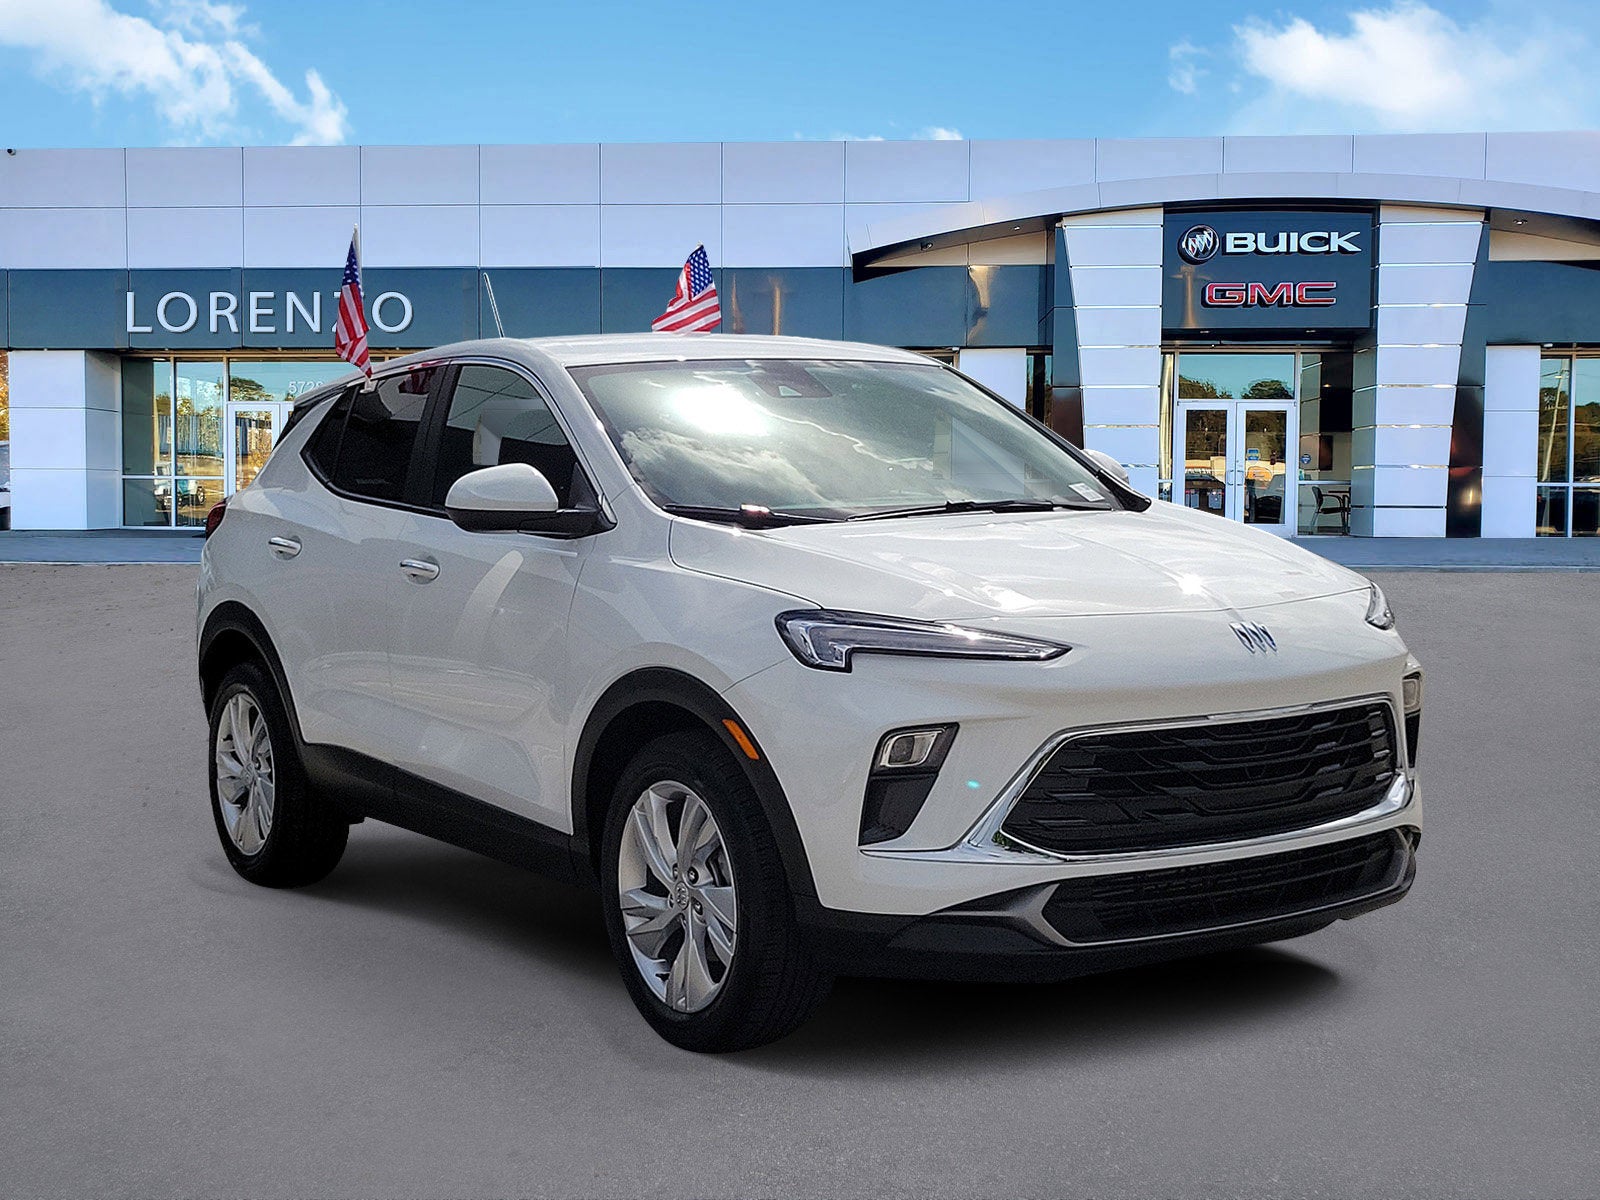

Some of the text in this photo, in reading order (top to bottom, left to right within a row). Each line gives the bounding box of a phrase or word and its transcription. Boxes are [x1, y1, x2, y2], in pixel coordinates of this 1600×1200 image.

[1225, 231, 1362, 253] BUICK
[1205, 281, 1337, 305] GMC
[126, 291, 413, 333] LORENO
